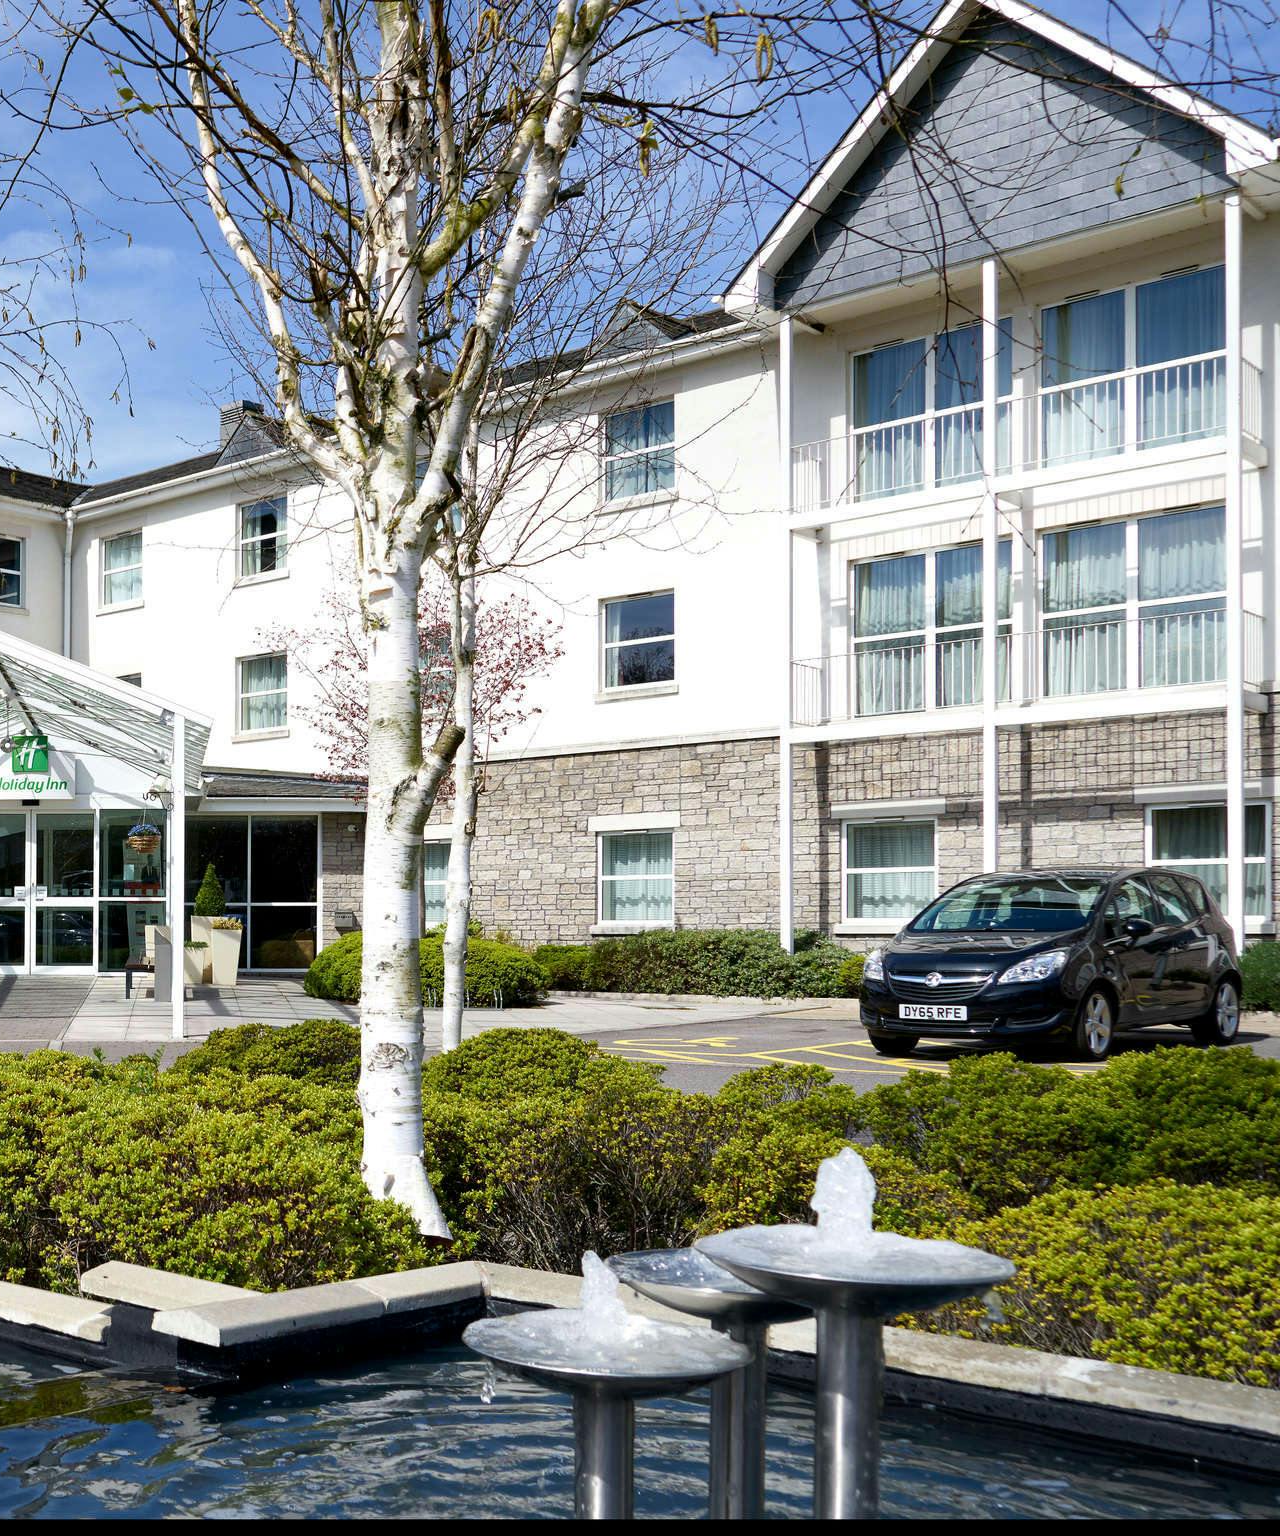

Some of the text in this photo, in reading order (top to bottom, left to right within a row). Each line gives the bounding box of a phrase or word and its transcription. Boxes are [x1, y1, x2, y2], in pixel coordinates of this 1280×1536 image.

[46, 776, 68, 790] Inn
[904, 1006, 962, 1019] DY65 RFE
